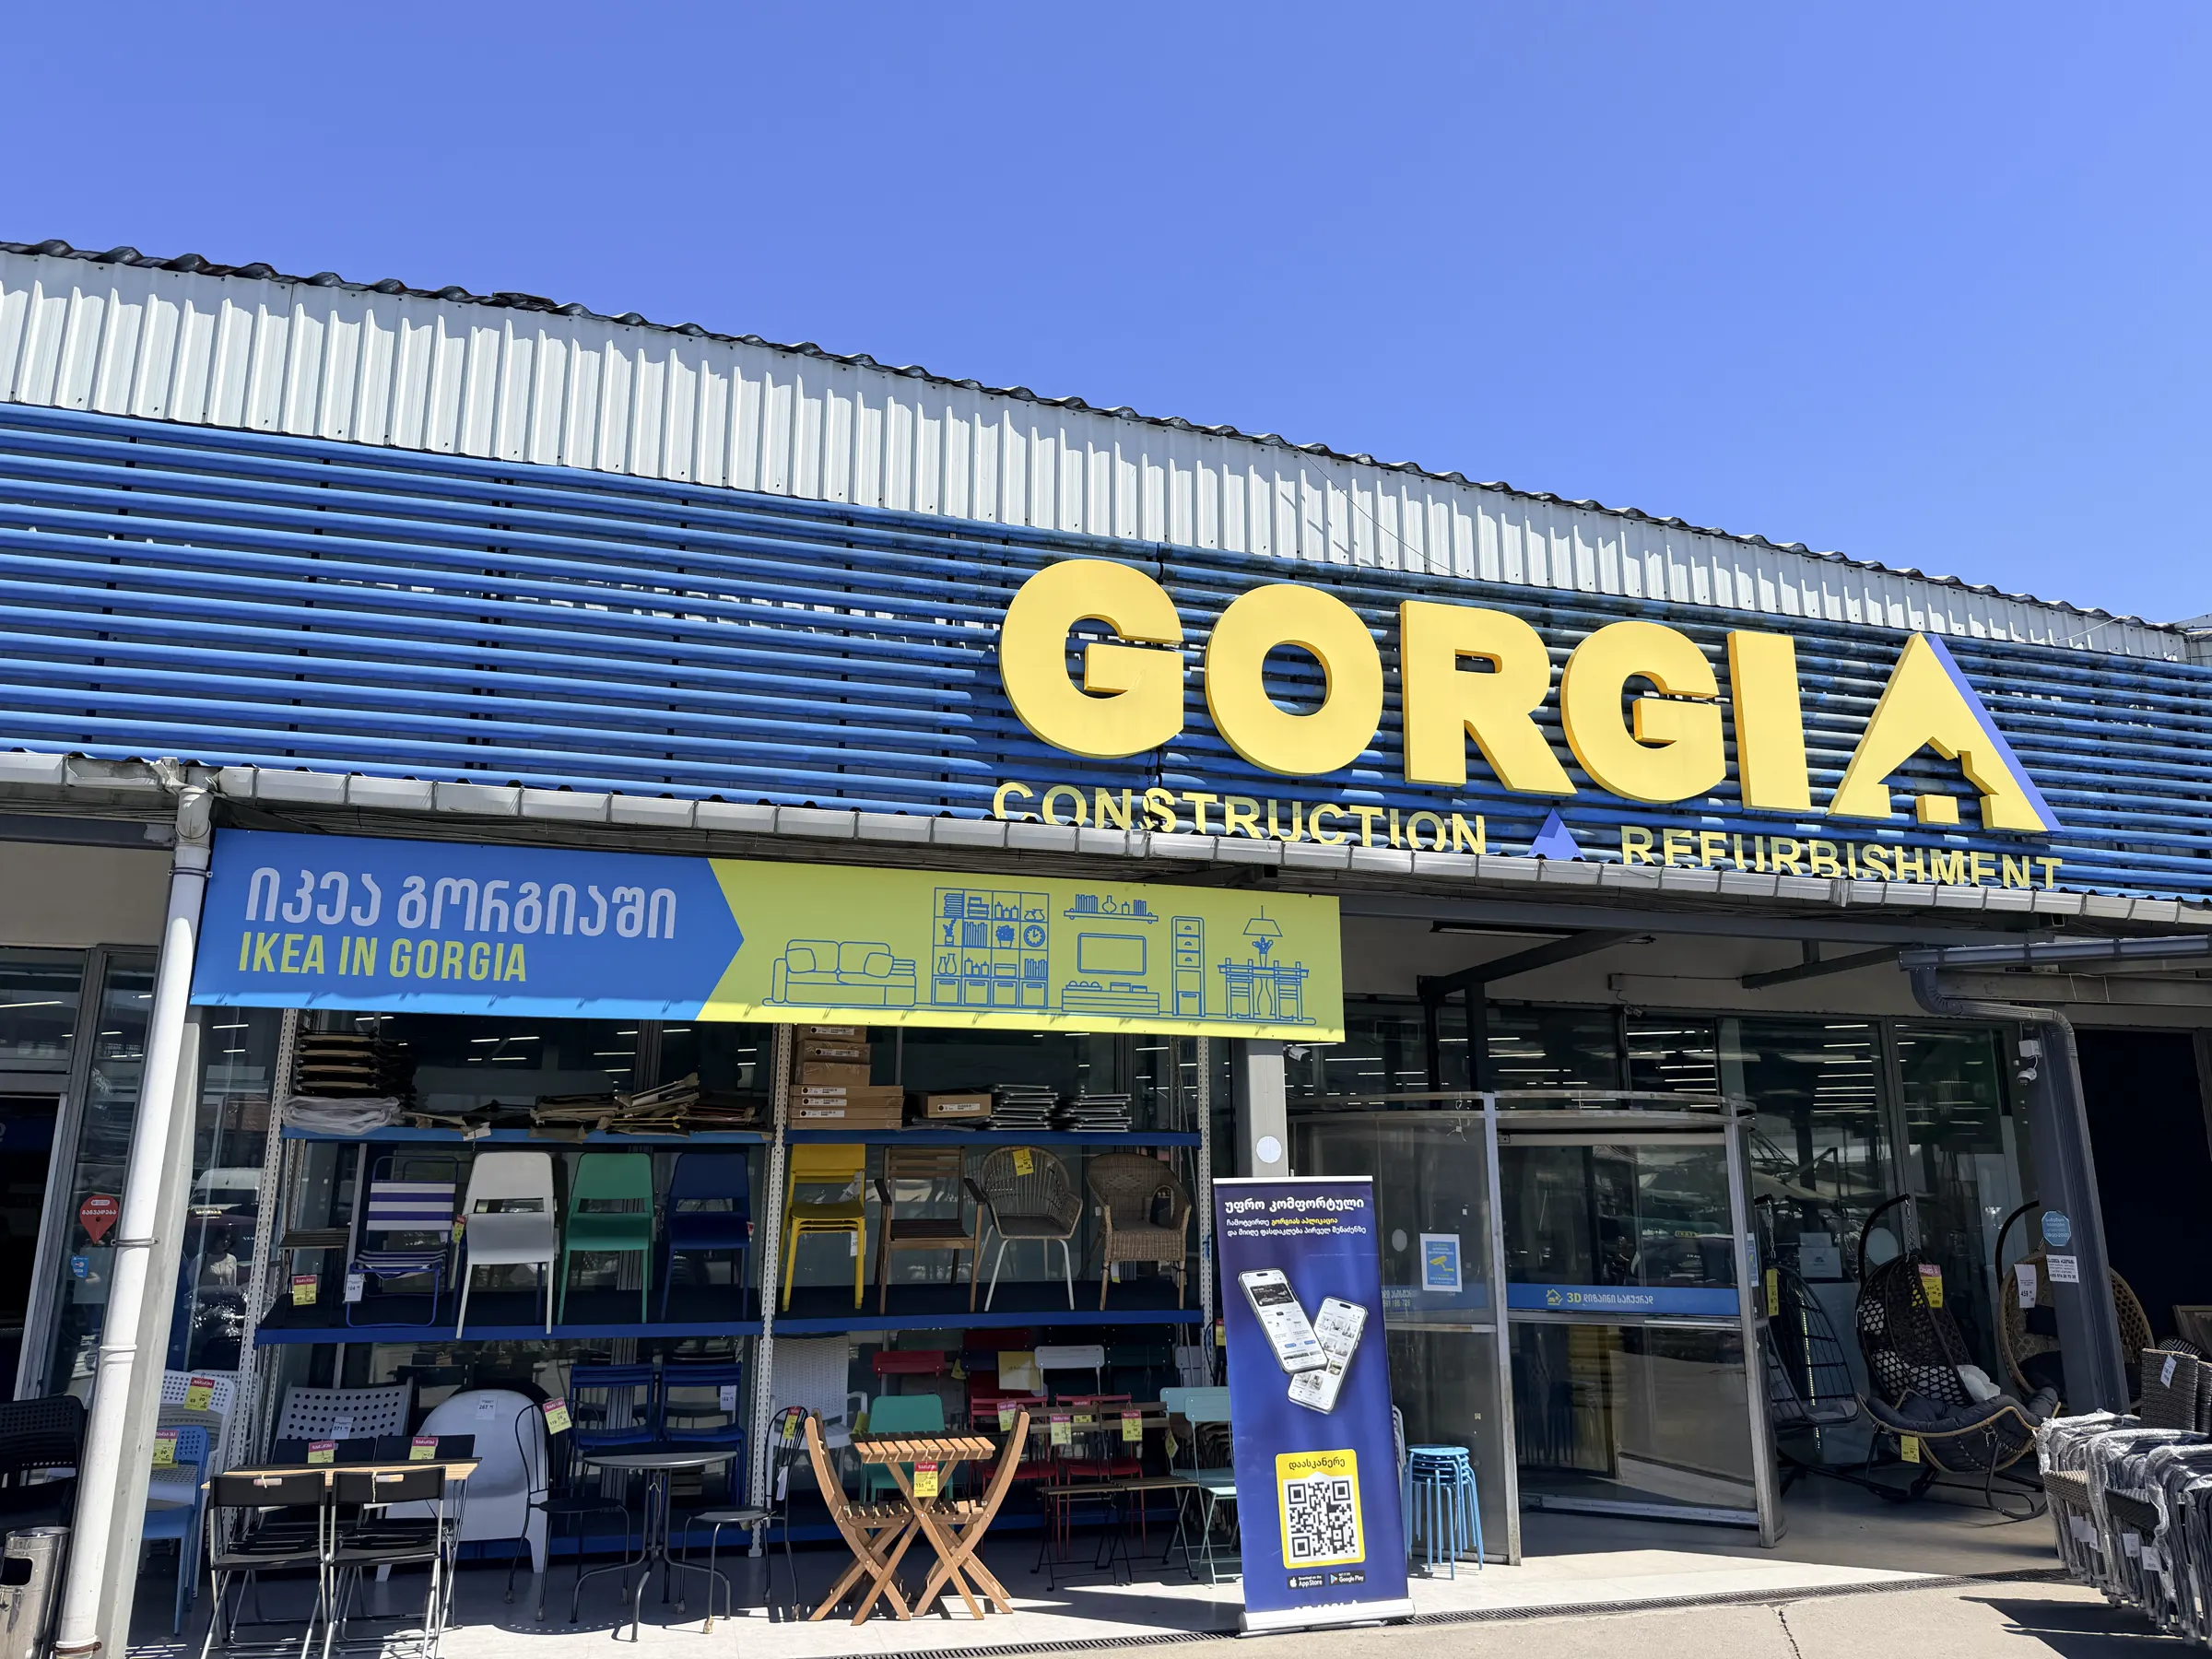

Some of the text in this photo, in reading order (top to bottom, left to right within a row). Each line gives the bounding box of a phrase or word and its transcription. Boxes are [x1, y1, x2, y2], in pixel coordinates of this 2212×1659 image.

[999, 559, 2061, 831] GORGIA
[993, 782, 2064, 890] CONSTRUCTION REFURBISHMENT
[244, 865, 677, 939] იკეა გორგიაში
[238, 931, 527, 982] IKEA IN GORGIA
[1225, 1195, 1364, 1214] უფრო კომფორტული
[1227, 1230, 1238, 1238] და
[1567, 1291, 1582, 1303] 3D
[1583, 1293, 1616, 1304] დიზაინი
[1288, 1456, 1346, 1471] დაასკანერე
[1299, 1578, 1323, 1588] App Store
[1355, 1574, 1364, 1583] Play
